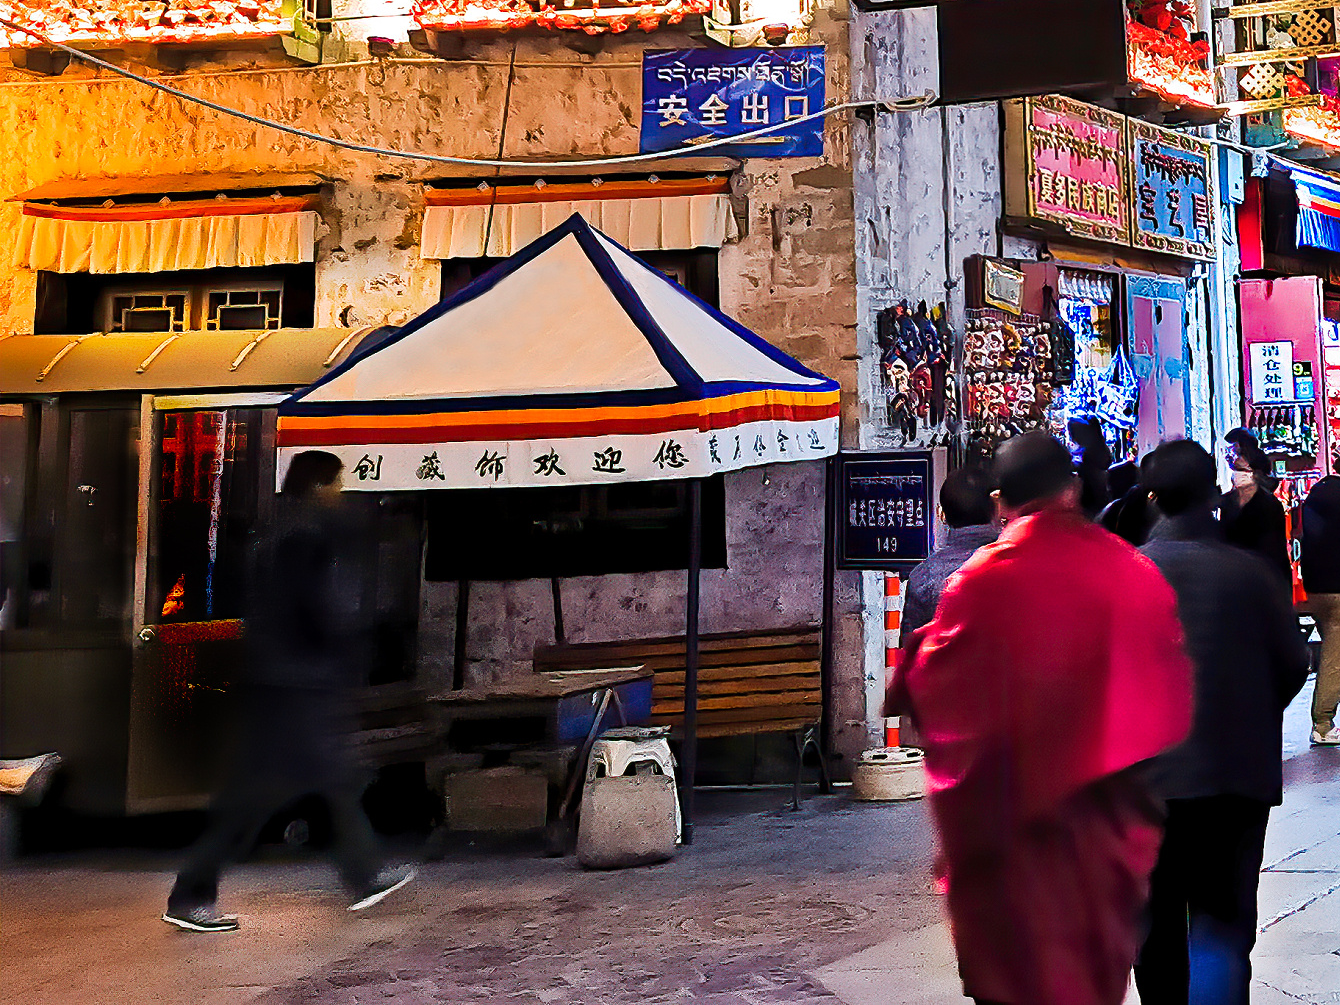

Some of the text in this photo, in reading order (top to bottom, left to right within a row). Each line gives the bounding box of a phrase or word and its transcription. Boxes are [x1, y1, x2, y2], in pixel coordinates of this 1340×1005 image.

[657, 91, 809, 127] 安全出口
[877, 537, 898, 553] 149
